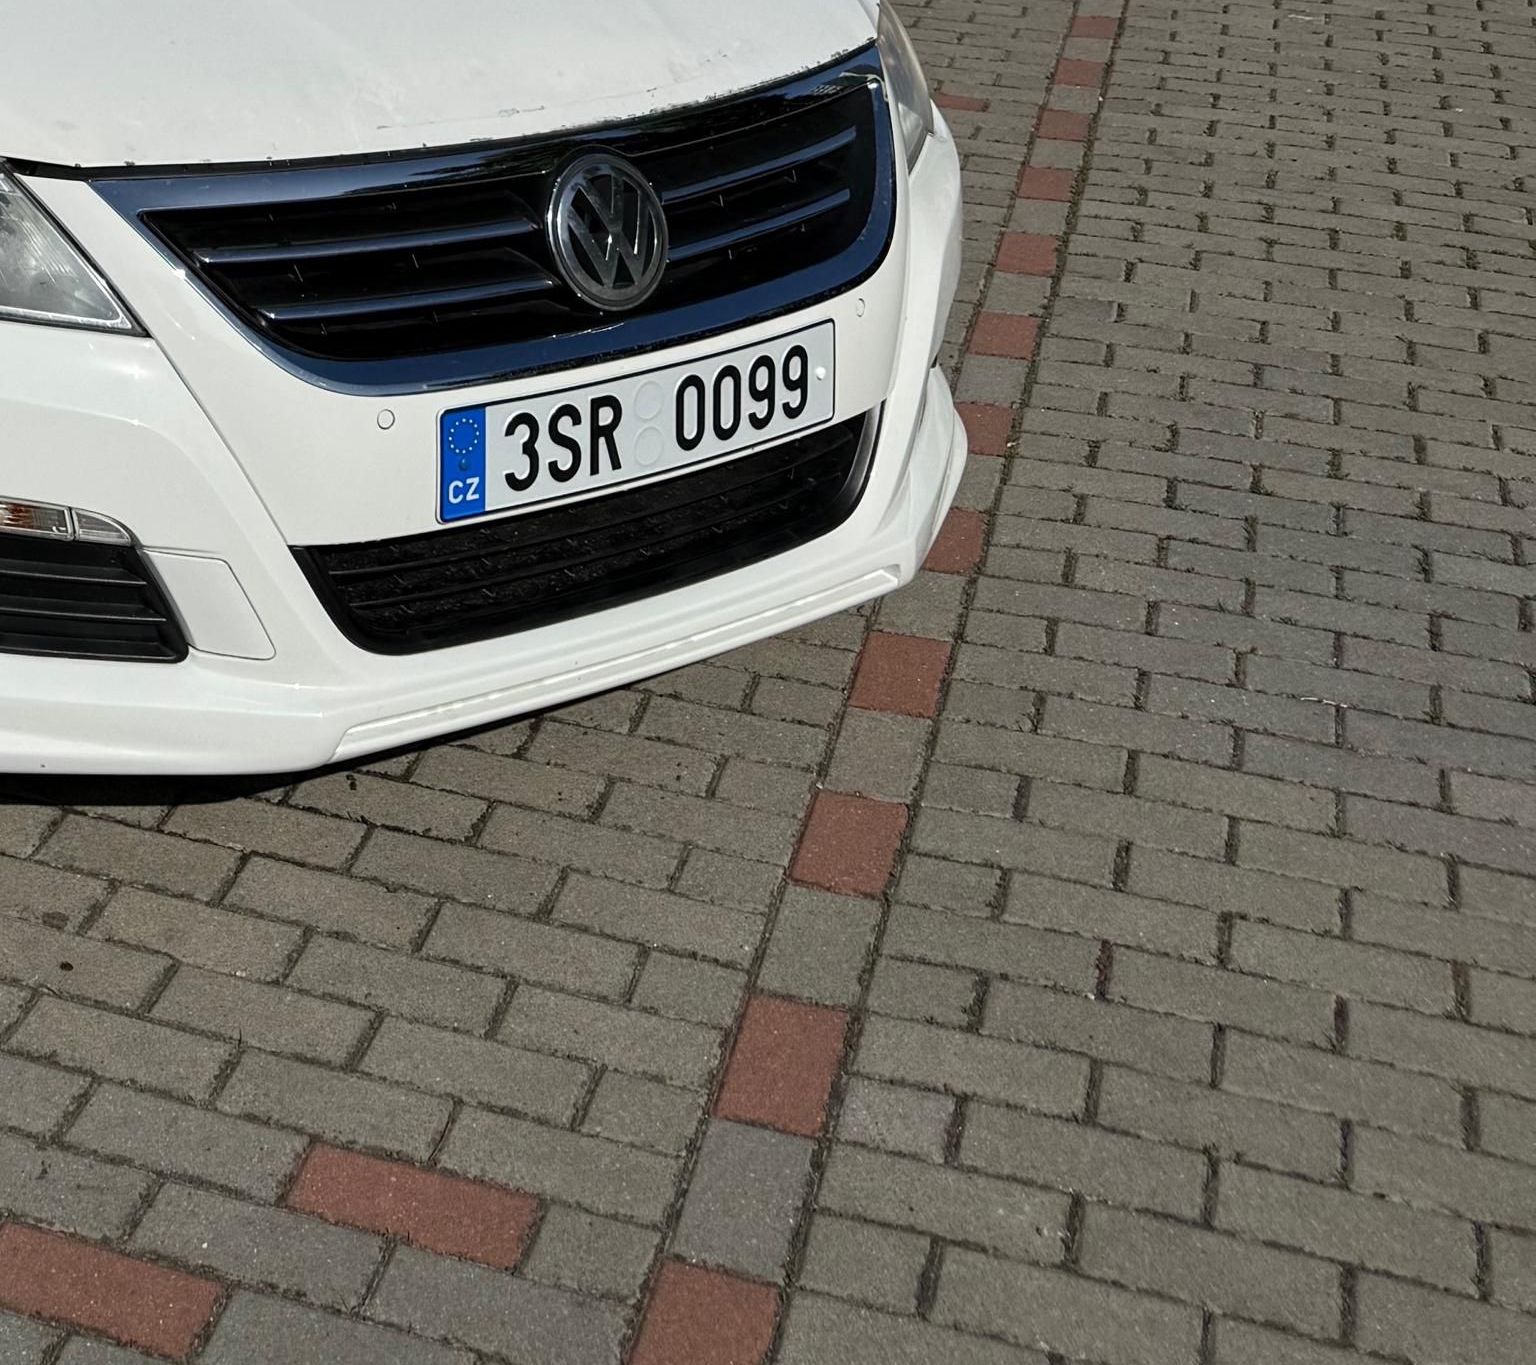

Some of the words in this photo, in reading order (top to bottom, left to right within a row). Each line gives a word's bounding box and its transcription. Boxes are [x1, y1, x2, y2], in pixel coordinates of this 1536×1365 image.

[503, 394, 624, 492] 3SR
[675, 343, 809, 452] 0099
[448, 476, 480, 504] CZ
